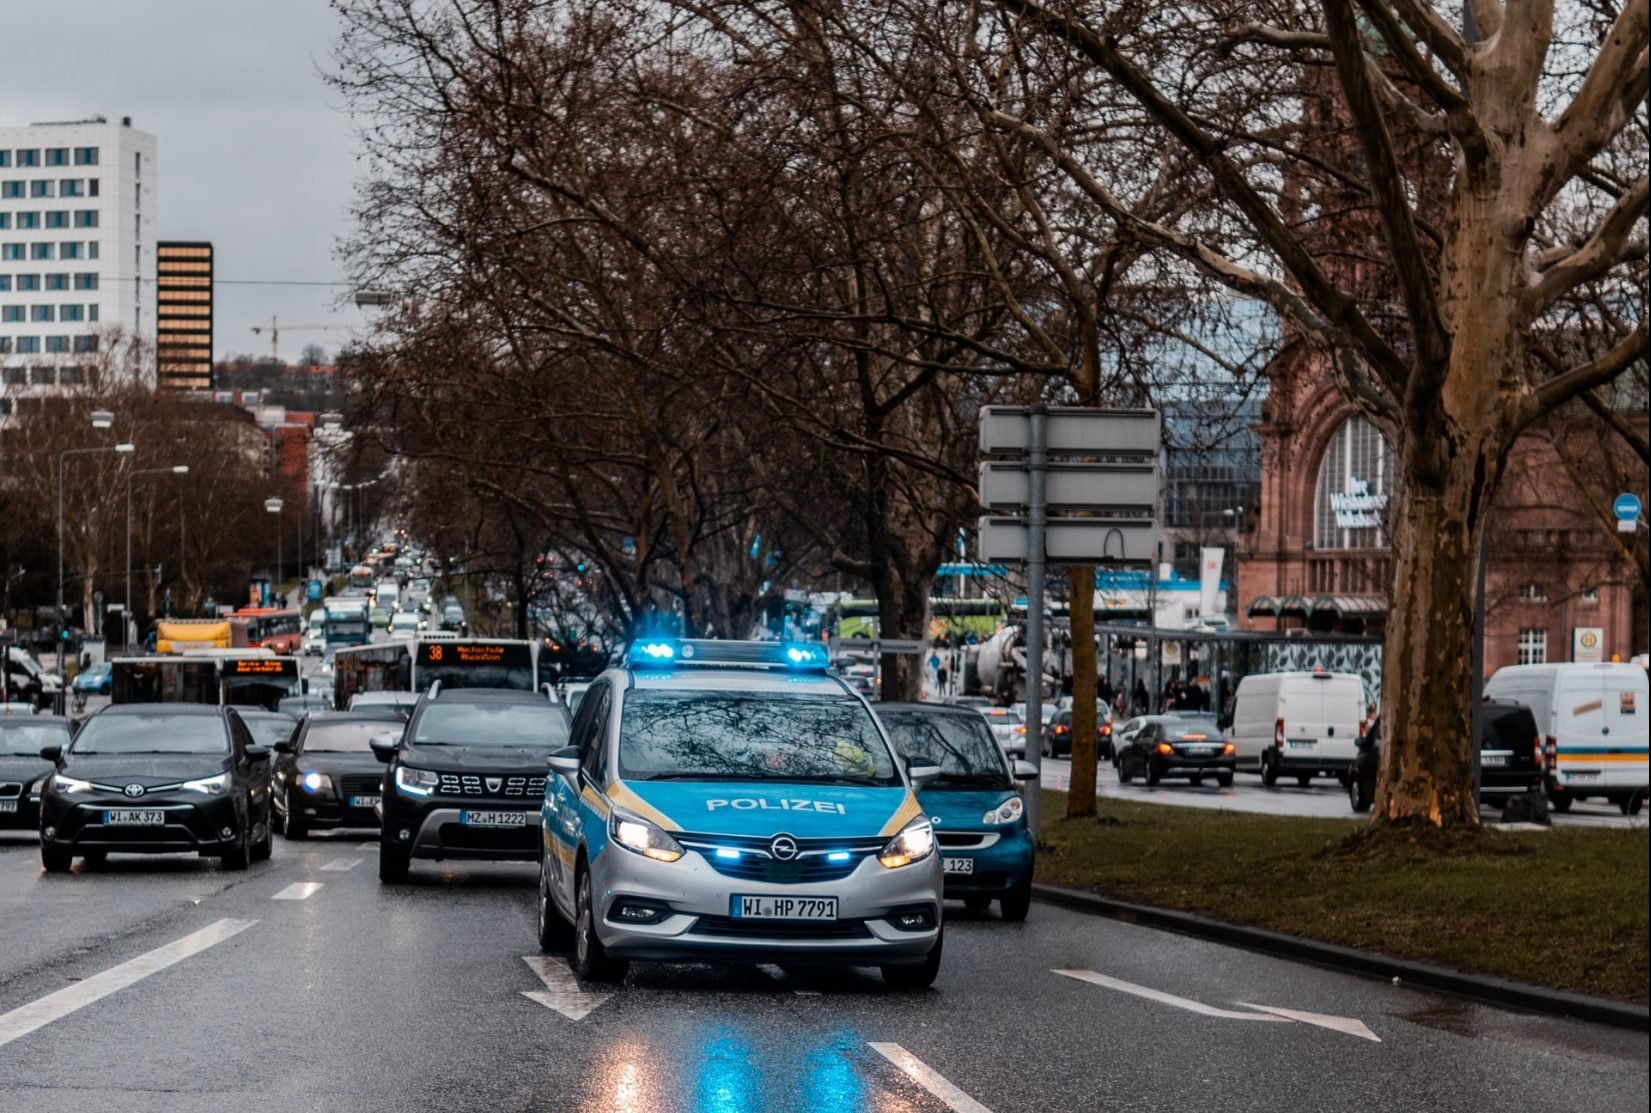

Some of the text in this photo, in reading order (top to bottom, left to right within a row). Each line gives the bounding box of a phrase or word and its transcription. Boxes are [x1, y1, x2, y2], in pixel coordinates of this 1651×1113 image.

[429, 645, 504, 660] 38 Hochschule
[706, 798, 846, 815] POLIZEI
[109, 811, 163, 822] WI AK 373
[467, 812, 525, 825] MZ H 1222
[949, 859, 972, 872] 123
[743, 898, 835, 918] WI HP 7791
